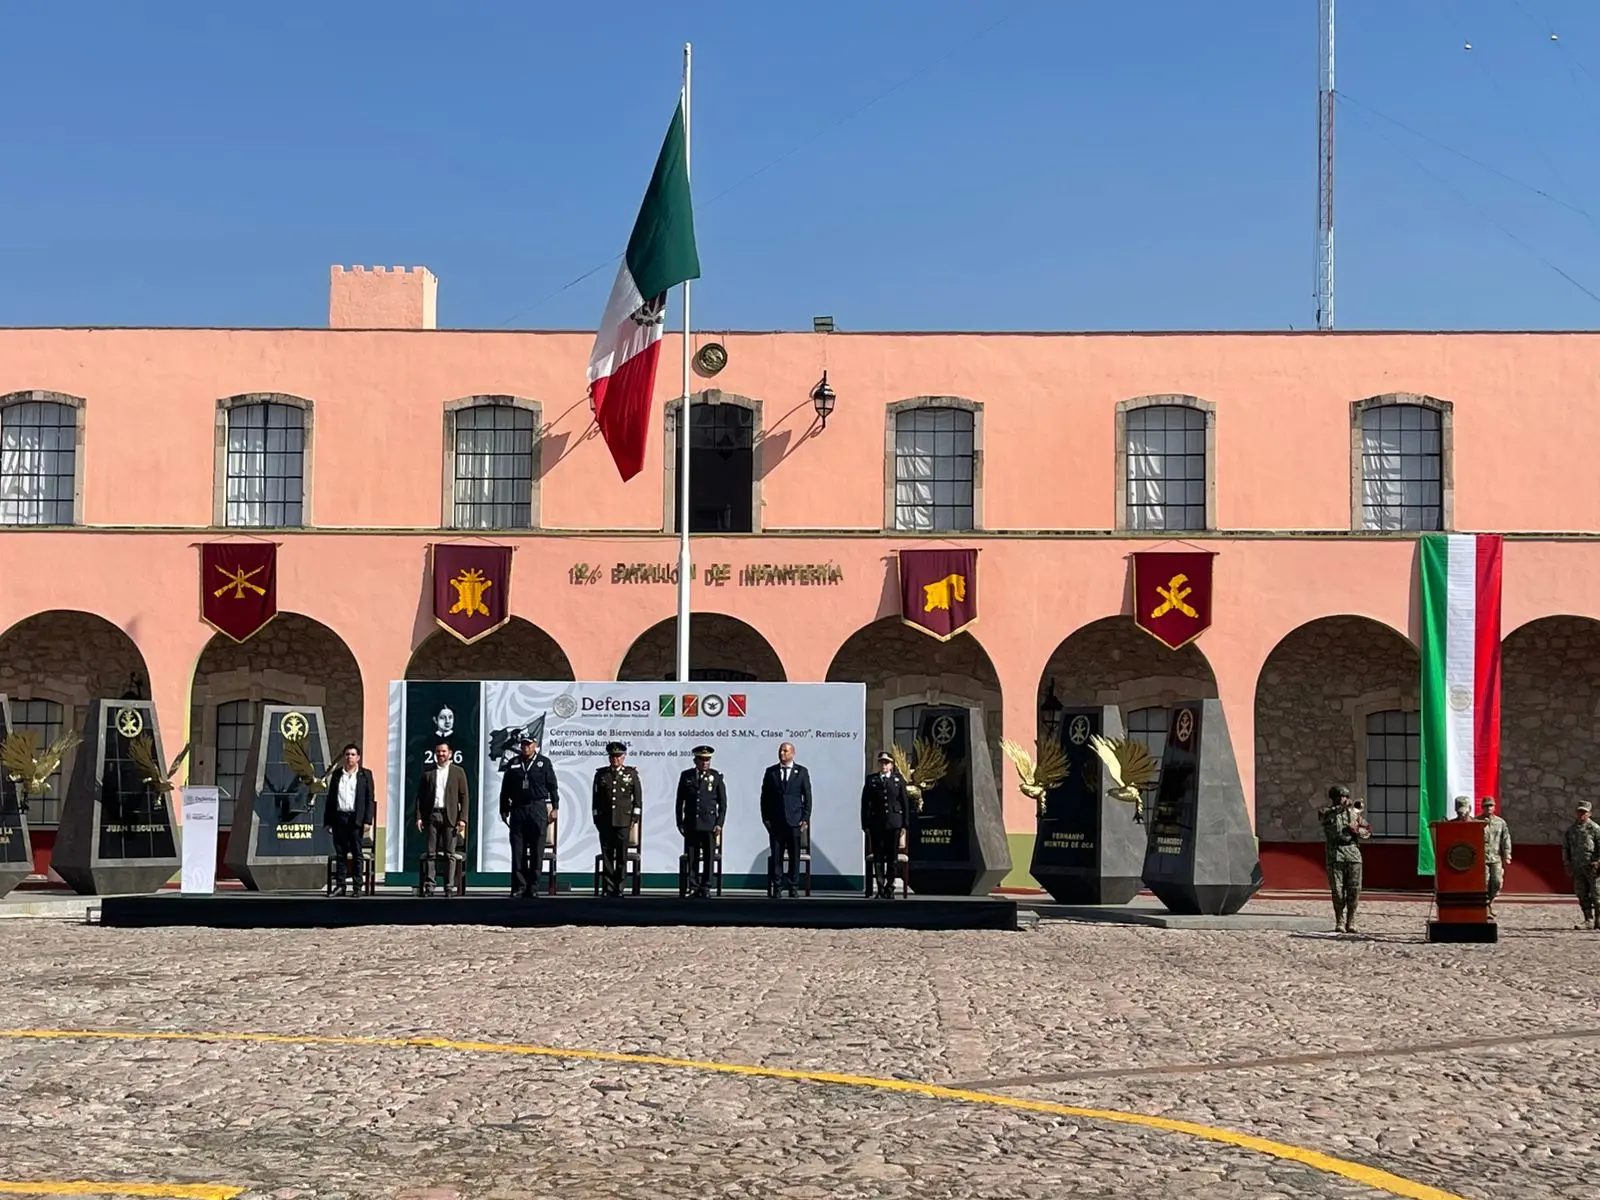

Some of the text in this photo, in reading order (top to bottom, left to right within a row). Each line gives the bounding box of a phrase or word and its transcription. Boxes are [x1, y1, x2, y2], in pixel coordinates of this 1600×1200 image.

[704, 563, 731, 586] DE
[581, 696, 651, 711] Defensa
[549, 728, 594, 737] Ceremonia
[596, 728, 607, 737] de
[609, 728, 655, 737] Bienvenida
[664, 728, 676, 737] los
[678, 728, 714, 738] soldados
[716, 728, 729, 738] del
[760, 729, 783, 738] Clase
[815, 729, 851, 738] Remisos
[852, 731, 859, 740] y
[549, 739, 583, 750] Mujeres
[423, 750, 463, 764] 26
[130, 824, 165, 833] ESCUTIA
[276, 832, 312, 840] MELGAR
